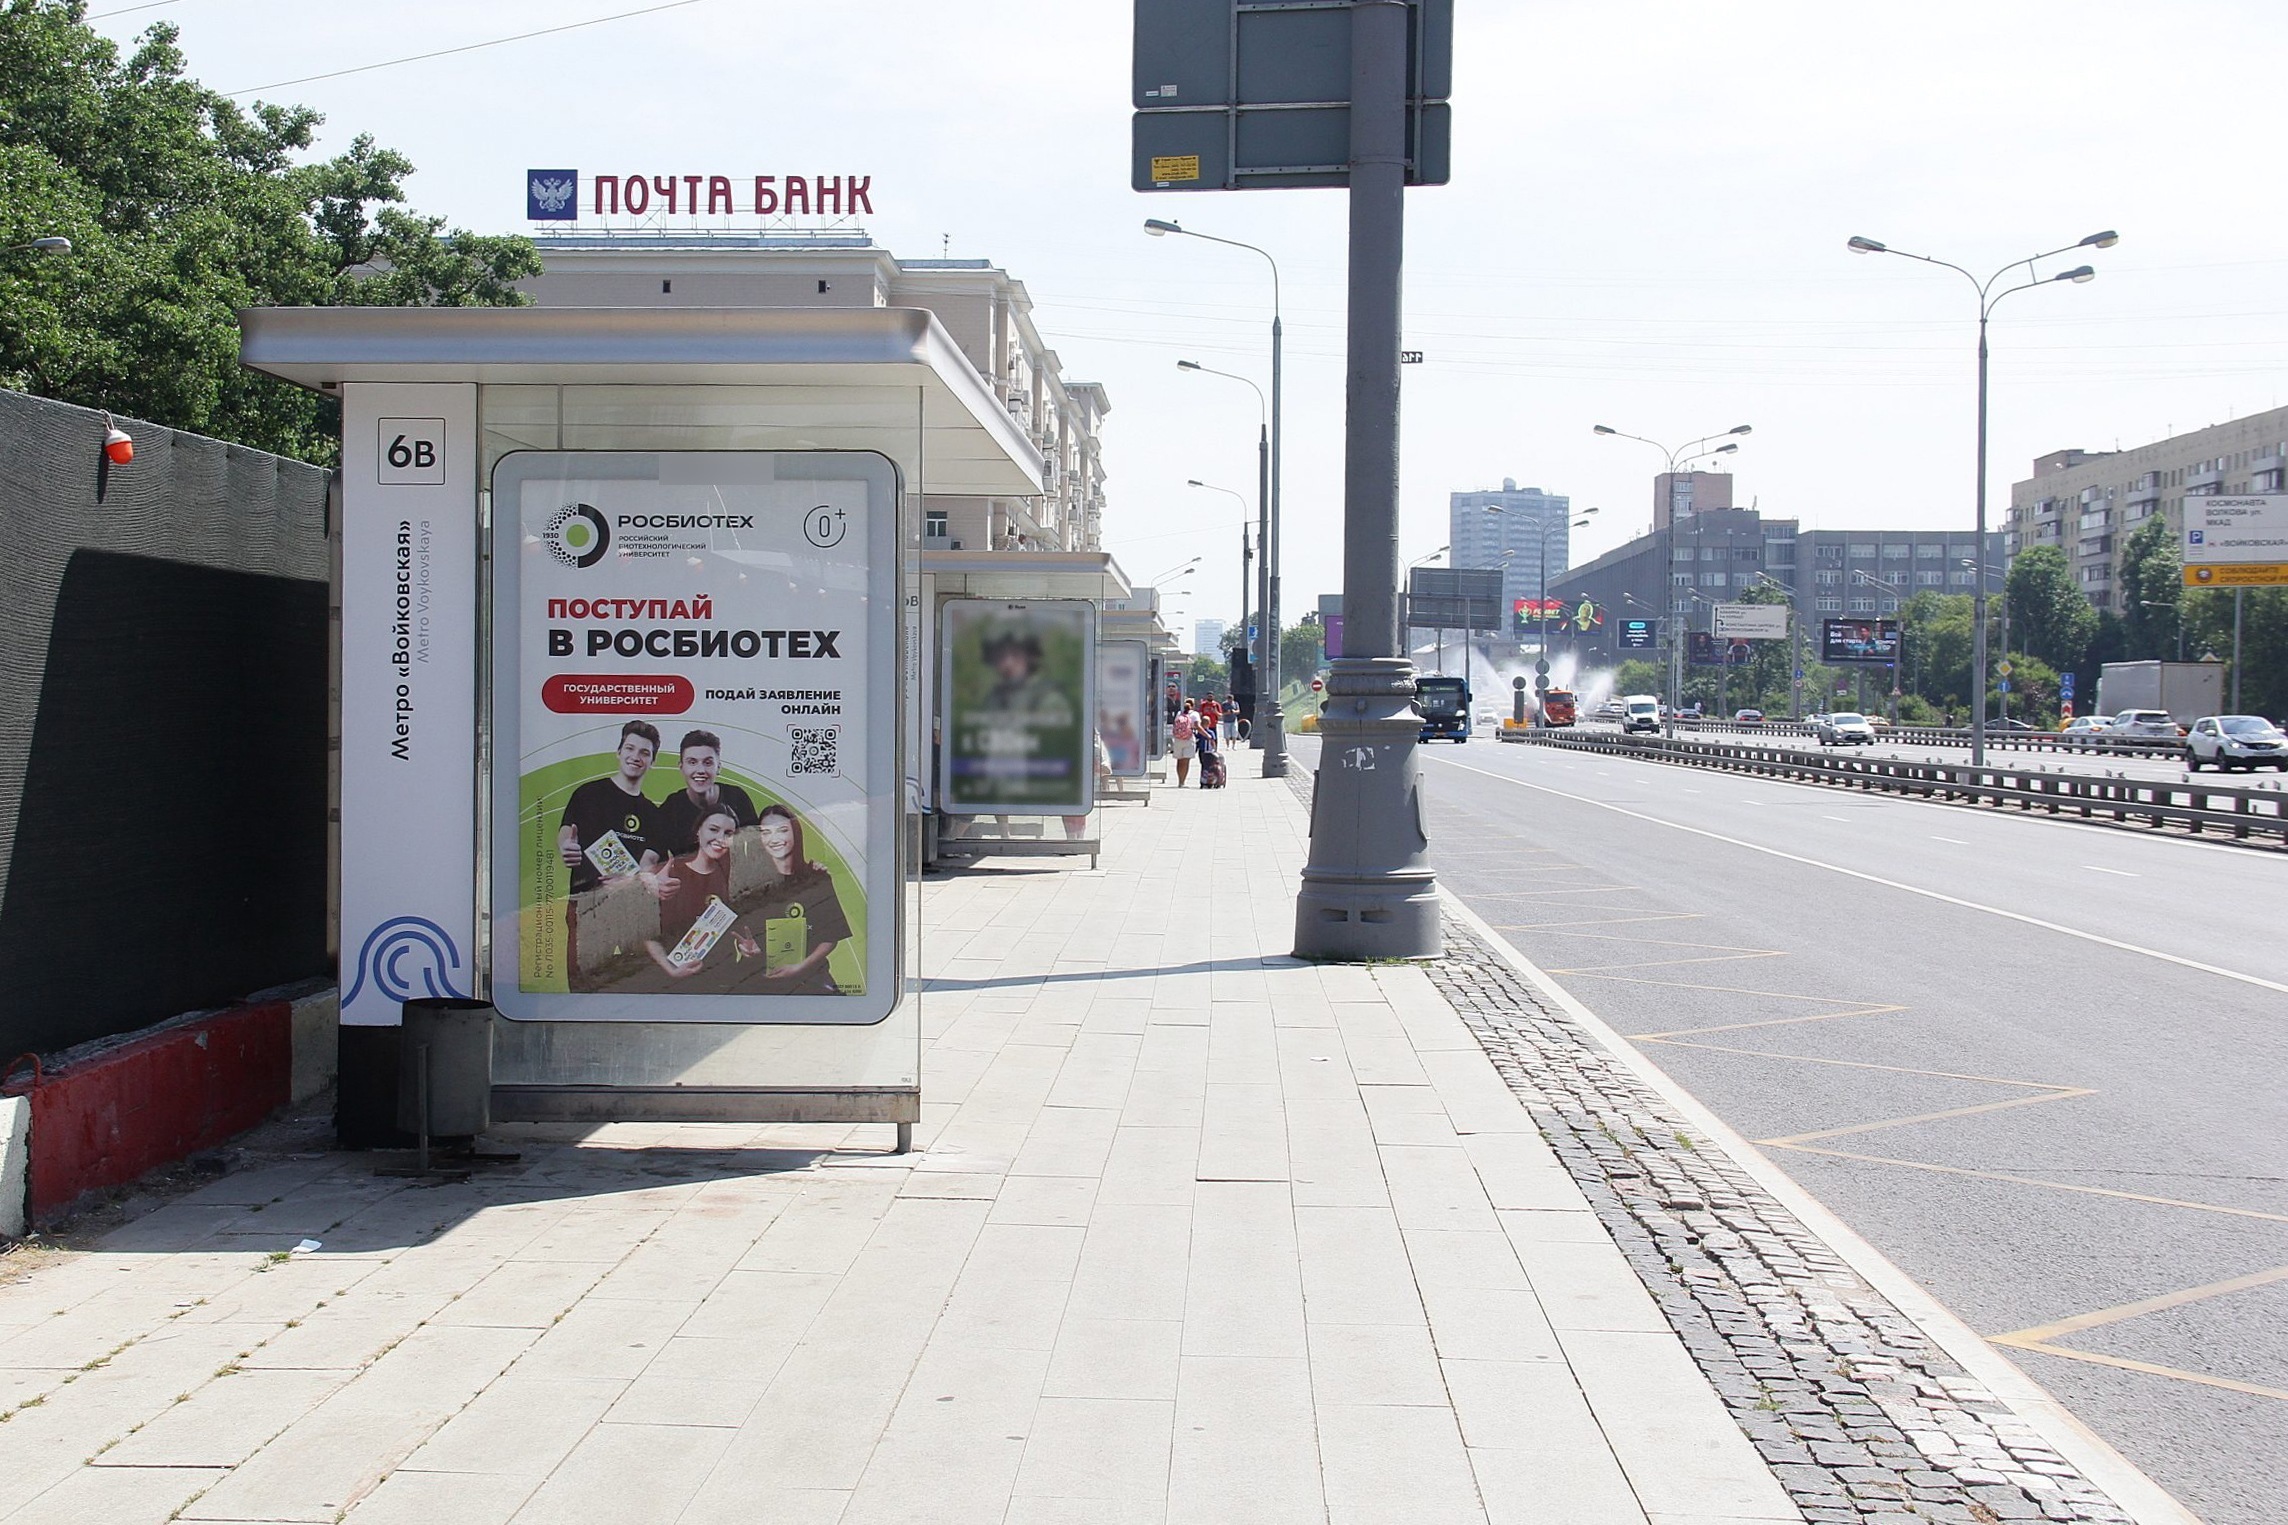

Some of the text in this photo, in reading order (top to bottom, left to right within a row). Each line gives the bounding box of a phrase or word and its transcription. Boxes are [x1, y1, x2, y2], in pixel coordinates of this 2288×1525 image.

[595, 174, 874, 215] ПОЧТА БАНК
[387, 434, 437, 468] 6В
[2206, 508, 2248, 517] ВОЛКОВА
[618, 514, 755, 529] РОСБИОТЕХ
[2206, 518, 2232, 527] МКАД
[618, 533, 669, 542] РОССИЙСКИЙ
[618, 541, 707, 550] БИОТЕХНОЛОГИЧЕСКИЙ
[417, 519, 433, 663] Metro Voykovskaya
[548, 593, 713, 620] ПОСТУПАЙ
[391, 520, 413, 761] Метро «Войковская»
[548, 629, 842, 659] В РОСБИОТЕХ
[563, 683, 676, 696] ГОСУДАРСТВЕННЫЙ
[705, 687, 842, 702] ПОДАЙ ЗАЯВЛЕНИЕ
[579, 695, 660, 706] УНИВЕРСИТЕТ
[781, 702, 842, 716] ОНЛАЙН
[536, 850, 544, 884] номер
